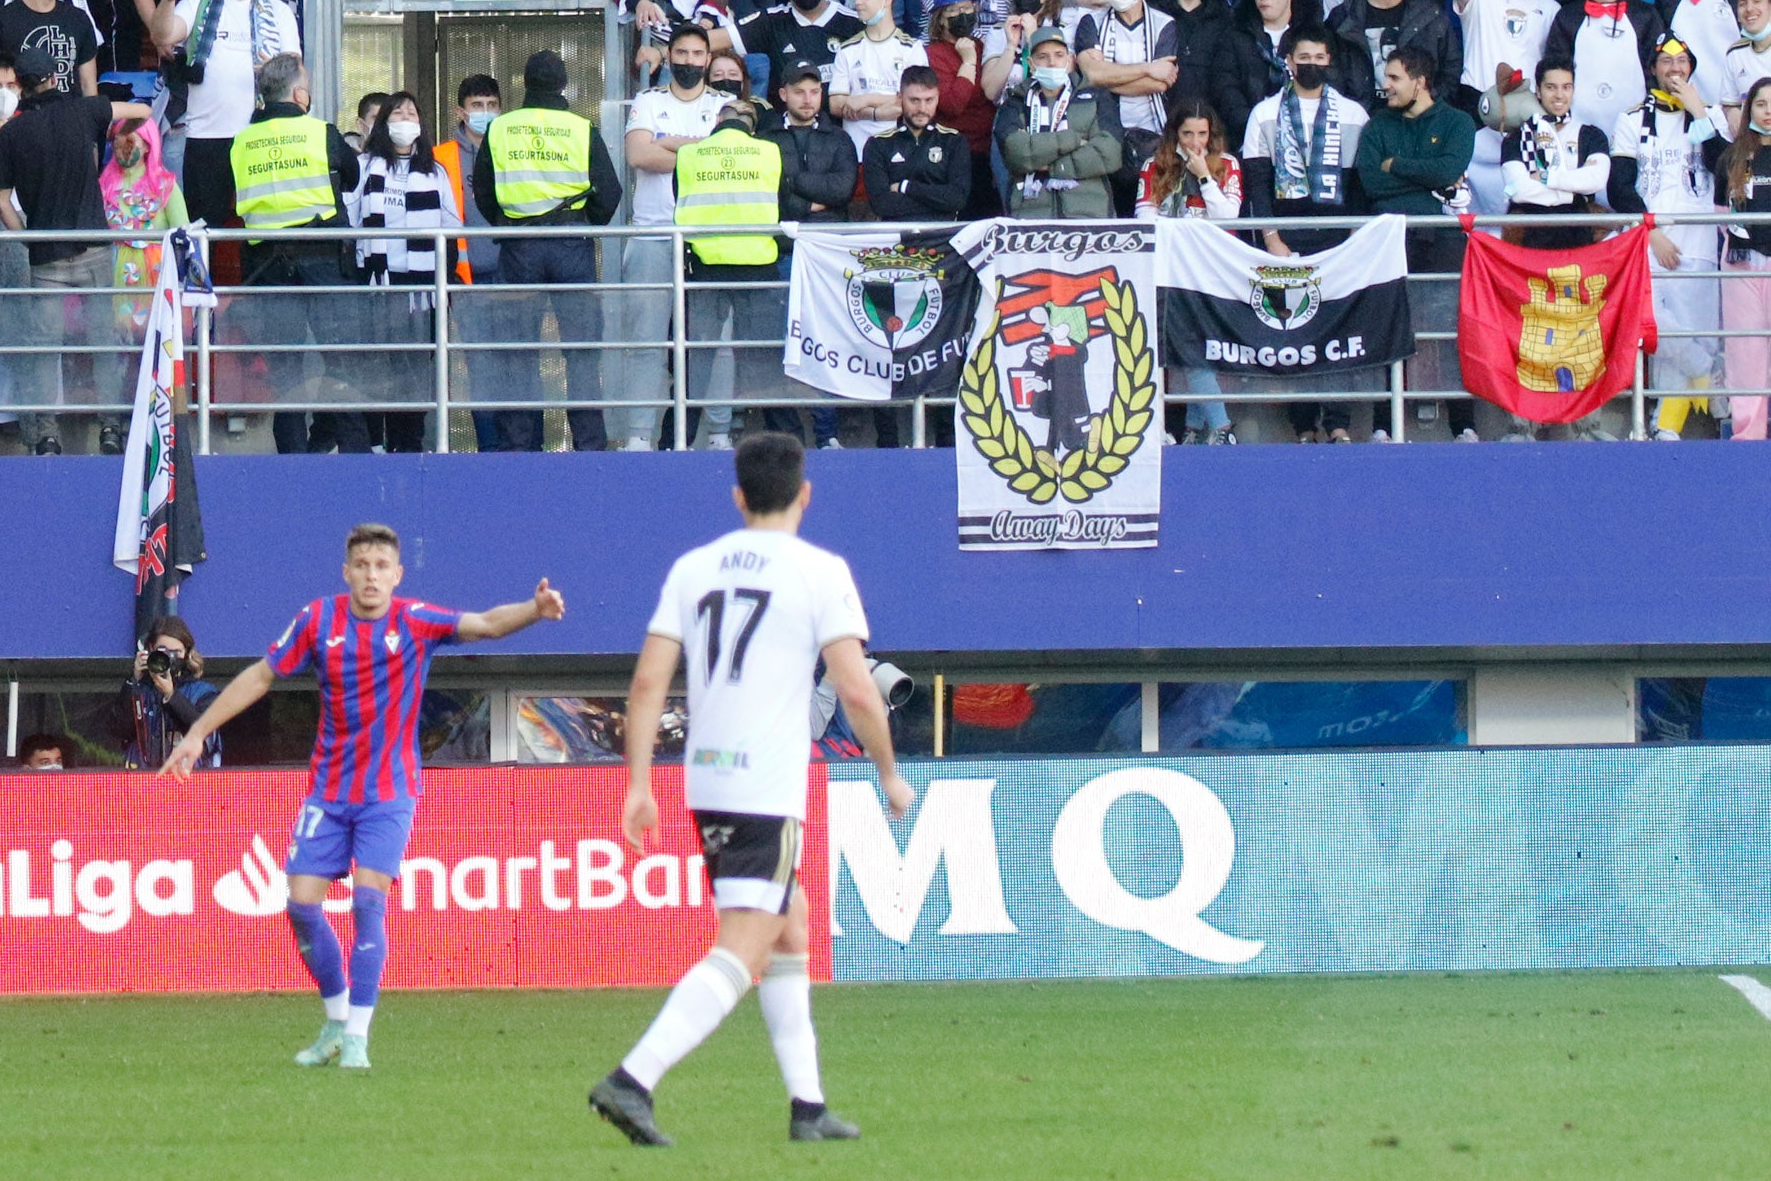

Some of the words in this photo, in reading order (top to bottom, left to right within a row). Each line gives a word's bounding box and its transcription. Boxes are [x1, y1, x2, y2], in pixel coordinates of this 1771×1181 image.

[246, 157, 309, 176] SEGURTASUNA
[507, 150, 570, 163] SEGURTASUNA
[695, 169, 761, 182] SEGURTASUNA
[1319, 173, 1338, 200] LA
[981, 224, 1146, 262] Burgos
[849, 282, 875, 335] BURGOS
[918, 286, 943, 336] FUTBOL
[846, 354, 905, 383] CLUB
[907, 349, 940, 378] DE
[1205, 339, 1318, 368] BURGOS
[1324, 335, 1367, 363] C.F.
[989, 509, 1061, 546] Away
[1063, 508, 1129, 547] Days
[719, 550, 771, 572] ANDY
[695, 587, 773, 688] 17
